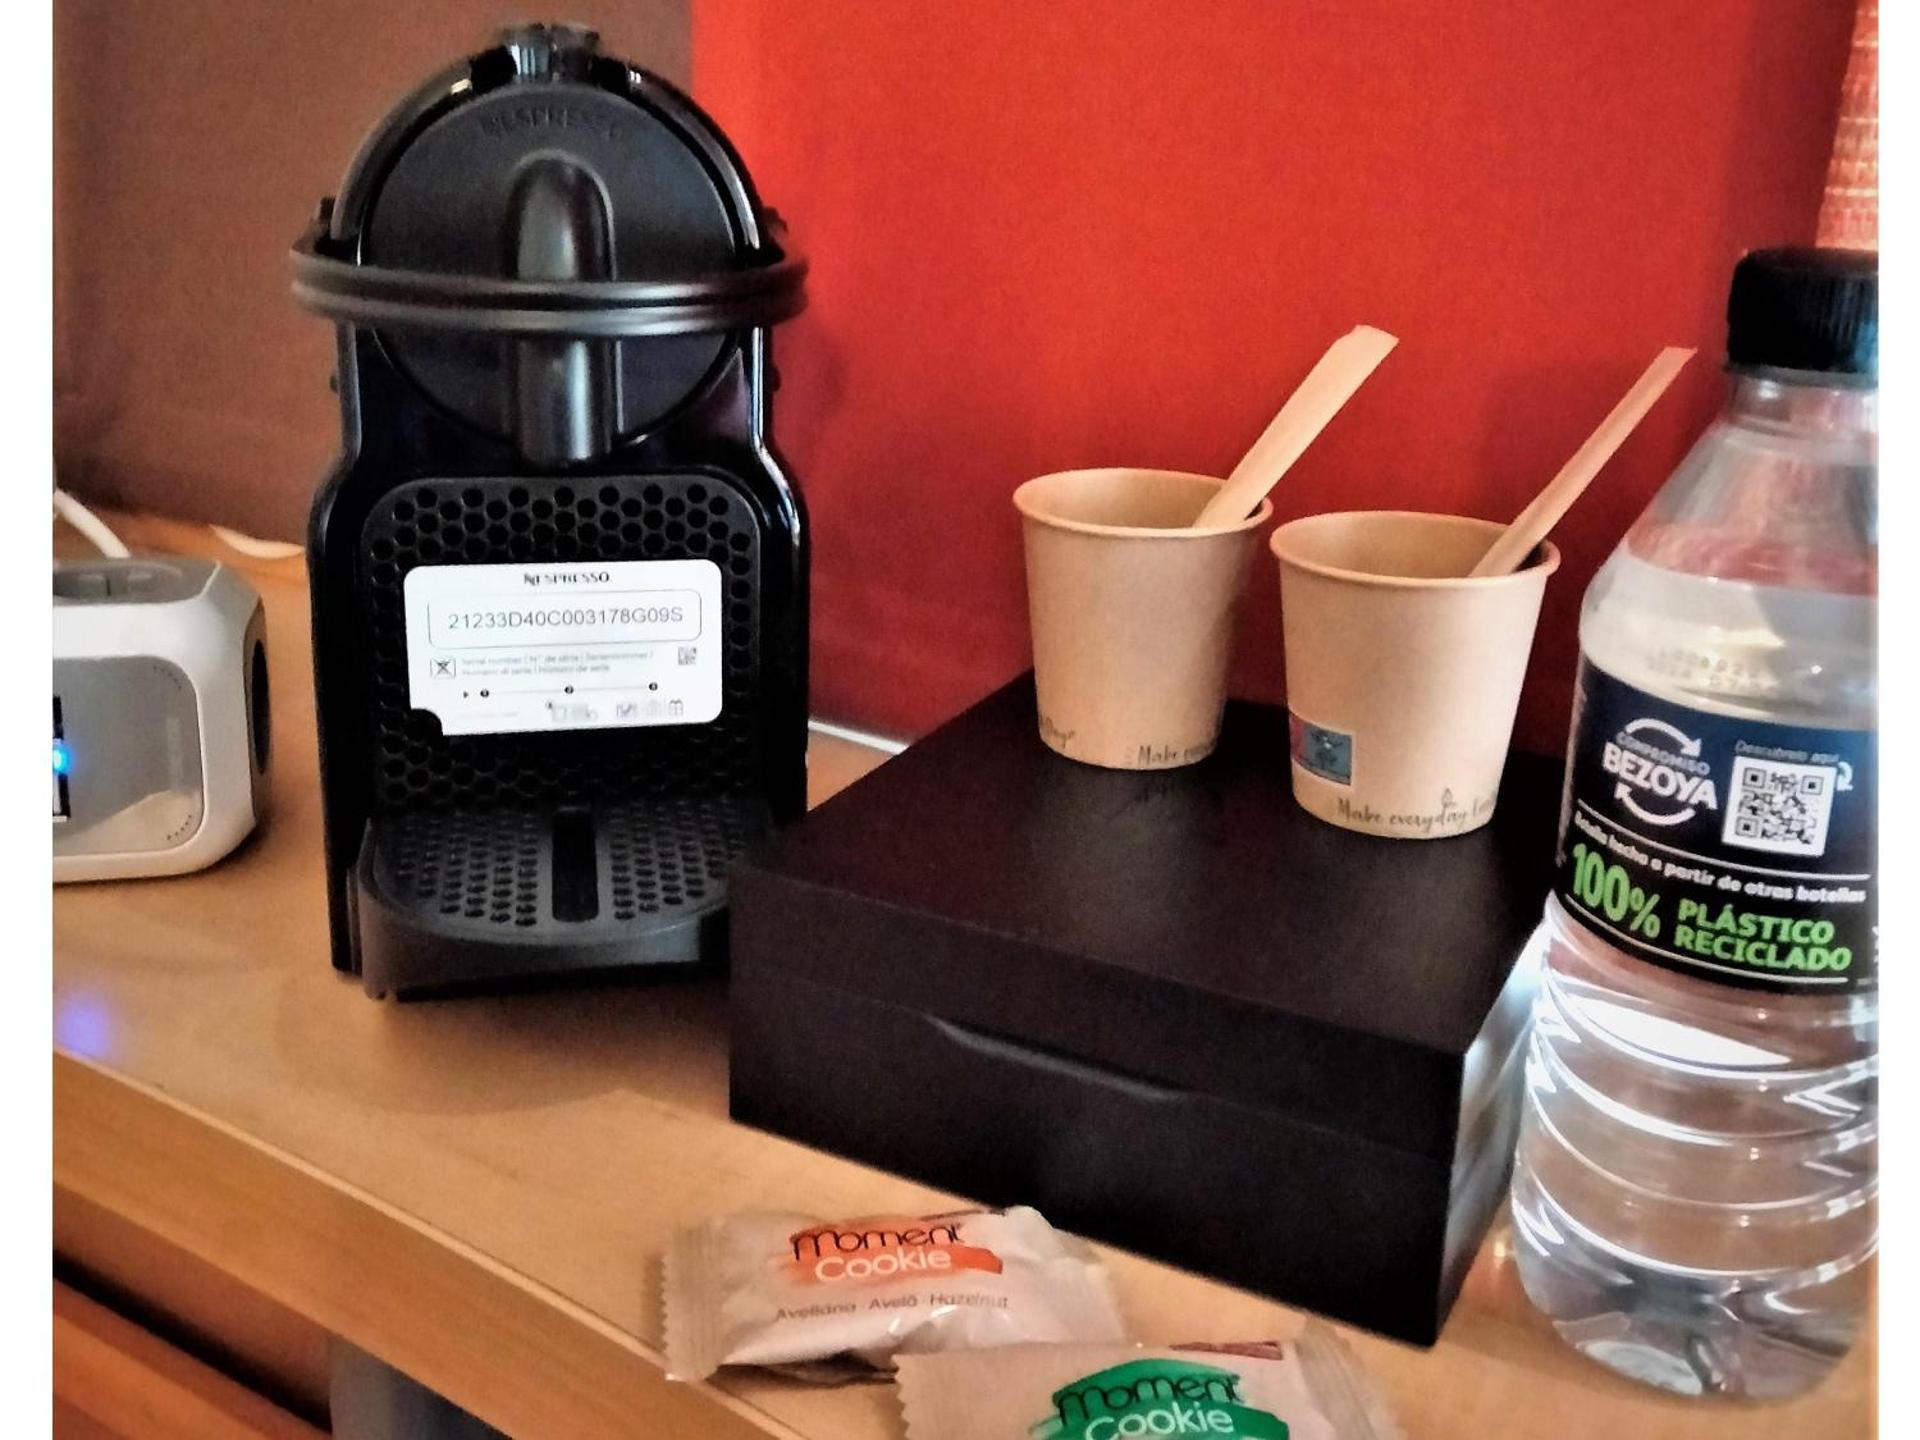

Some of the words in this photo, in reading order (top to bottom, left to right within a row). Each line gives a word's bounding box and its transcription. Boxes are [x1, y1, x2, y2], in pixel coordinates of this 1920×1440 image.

[523, 571, 610, 586] NESPRESSO
[448, 606, 684, 631] 21233D40C003178G09S
[1602, 740, 1718, 811] BEZOYA
[1336, 795, 1382, 822] Make
[1572, 842, 1661, 939] 100%
[1649, 857, 1663, 872] a
[1663, 861, 1716, 887] partir
[1716, 873, 1743, 893] de
[1743, 880, 1795, 901] otras
[1795, 884, 1867, 904] botellas
[1677, 897, 1836, 946] PLÁSTICO
[1673, 923, 1854, 972] RECICLADO
[814, 1243, 953, 1283] Cookie
[930, 1293, 1009, 1309] Hazelnut
[1084, 1401, 1236, 1440] Cookie
